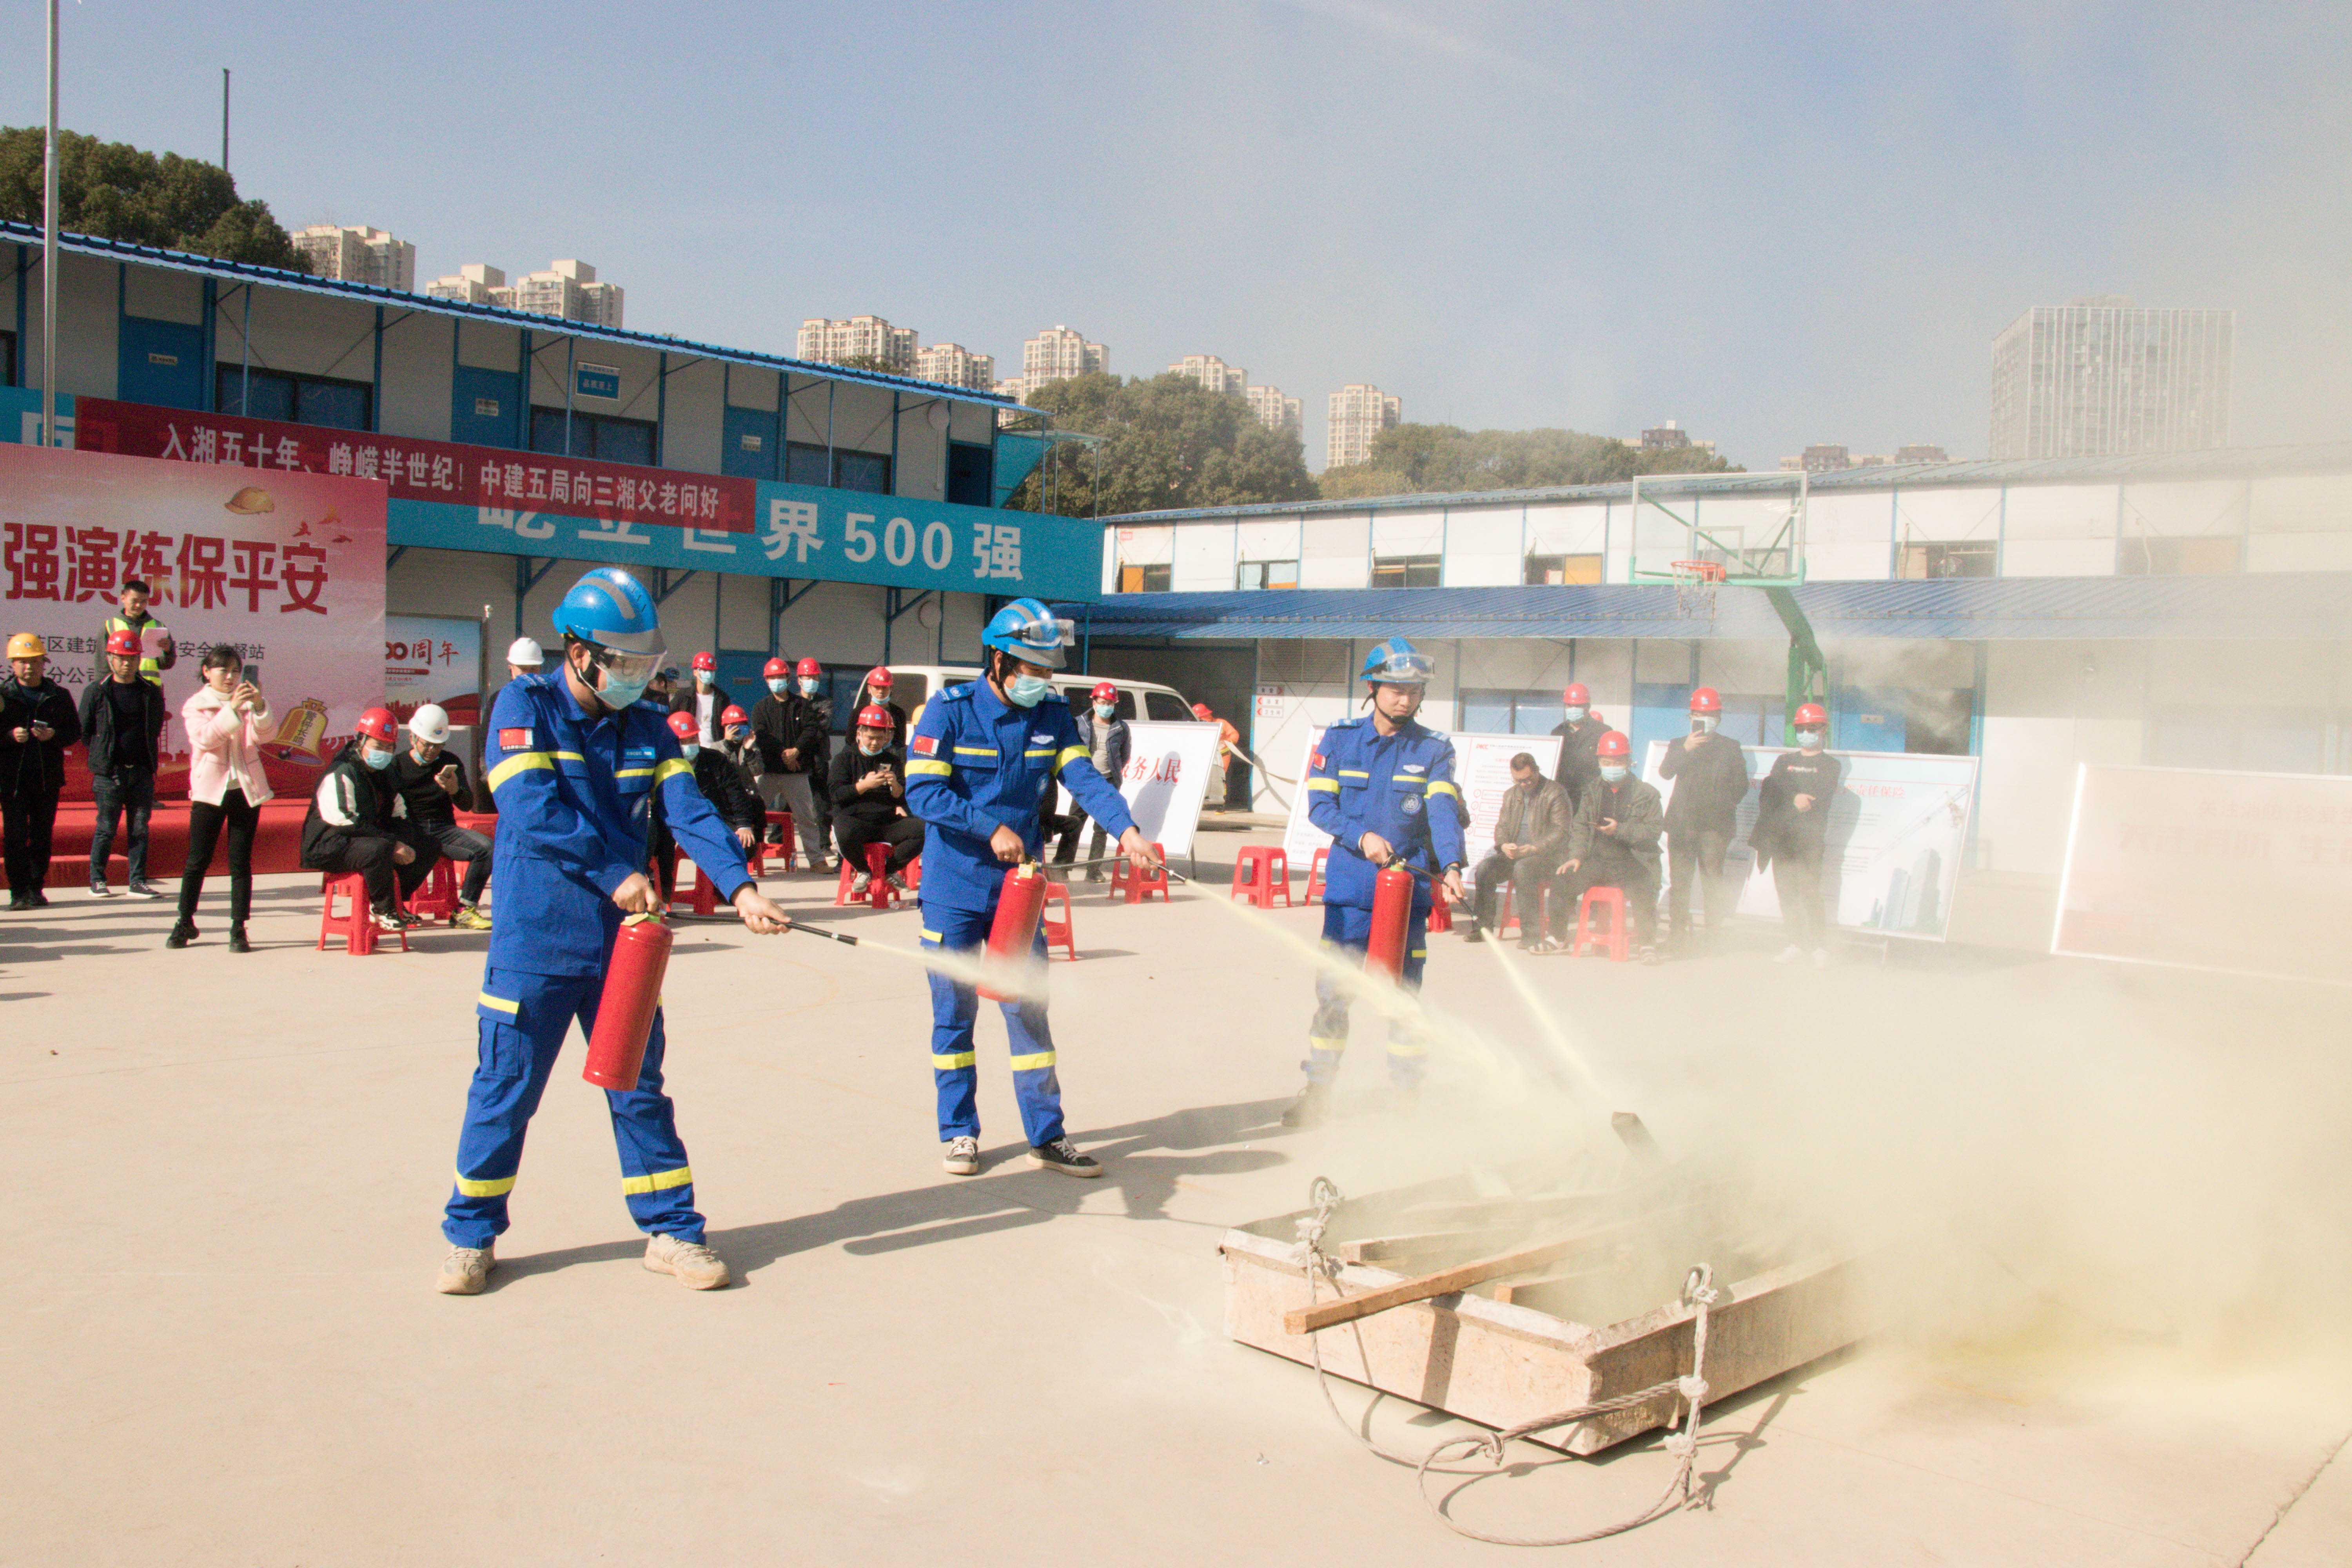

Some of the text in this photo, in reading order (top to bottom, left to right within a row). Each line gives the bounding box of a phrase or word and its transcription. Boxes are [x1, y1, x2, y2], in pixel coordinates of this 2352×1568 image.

[481, 460, 719, 519] 中建五局向三湘父老问好
[4, 522, 328, 615] 强演练保平安
